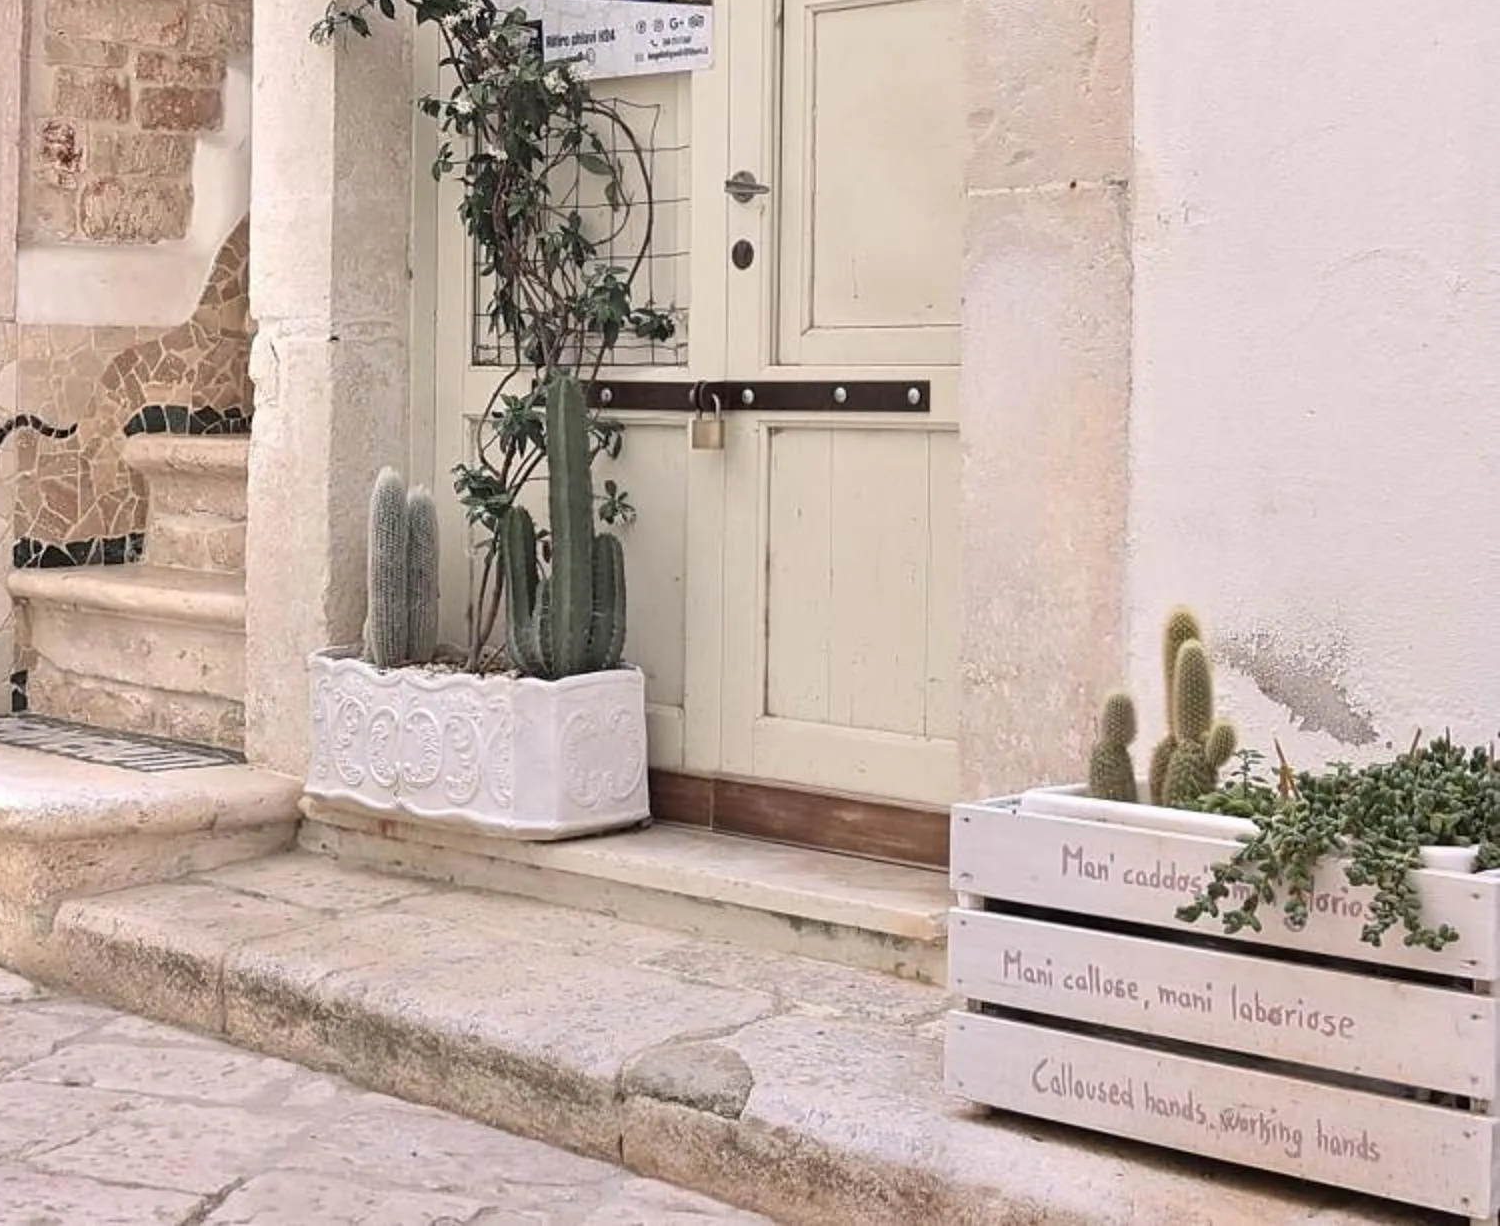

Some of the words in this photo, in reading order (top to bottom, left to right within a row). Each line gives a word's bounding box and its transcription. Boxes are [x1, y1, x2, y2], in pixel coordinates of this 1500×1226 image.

[1003, 949, 1053, 988] Mani
[1158, 982, 1213, 1013] mani
[1232, 985, 1356, 1040] laboriose
[1031, 1058, 1134, 1110] Calloused
[1316, 1118, 1381, 1162] hands
